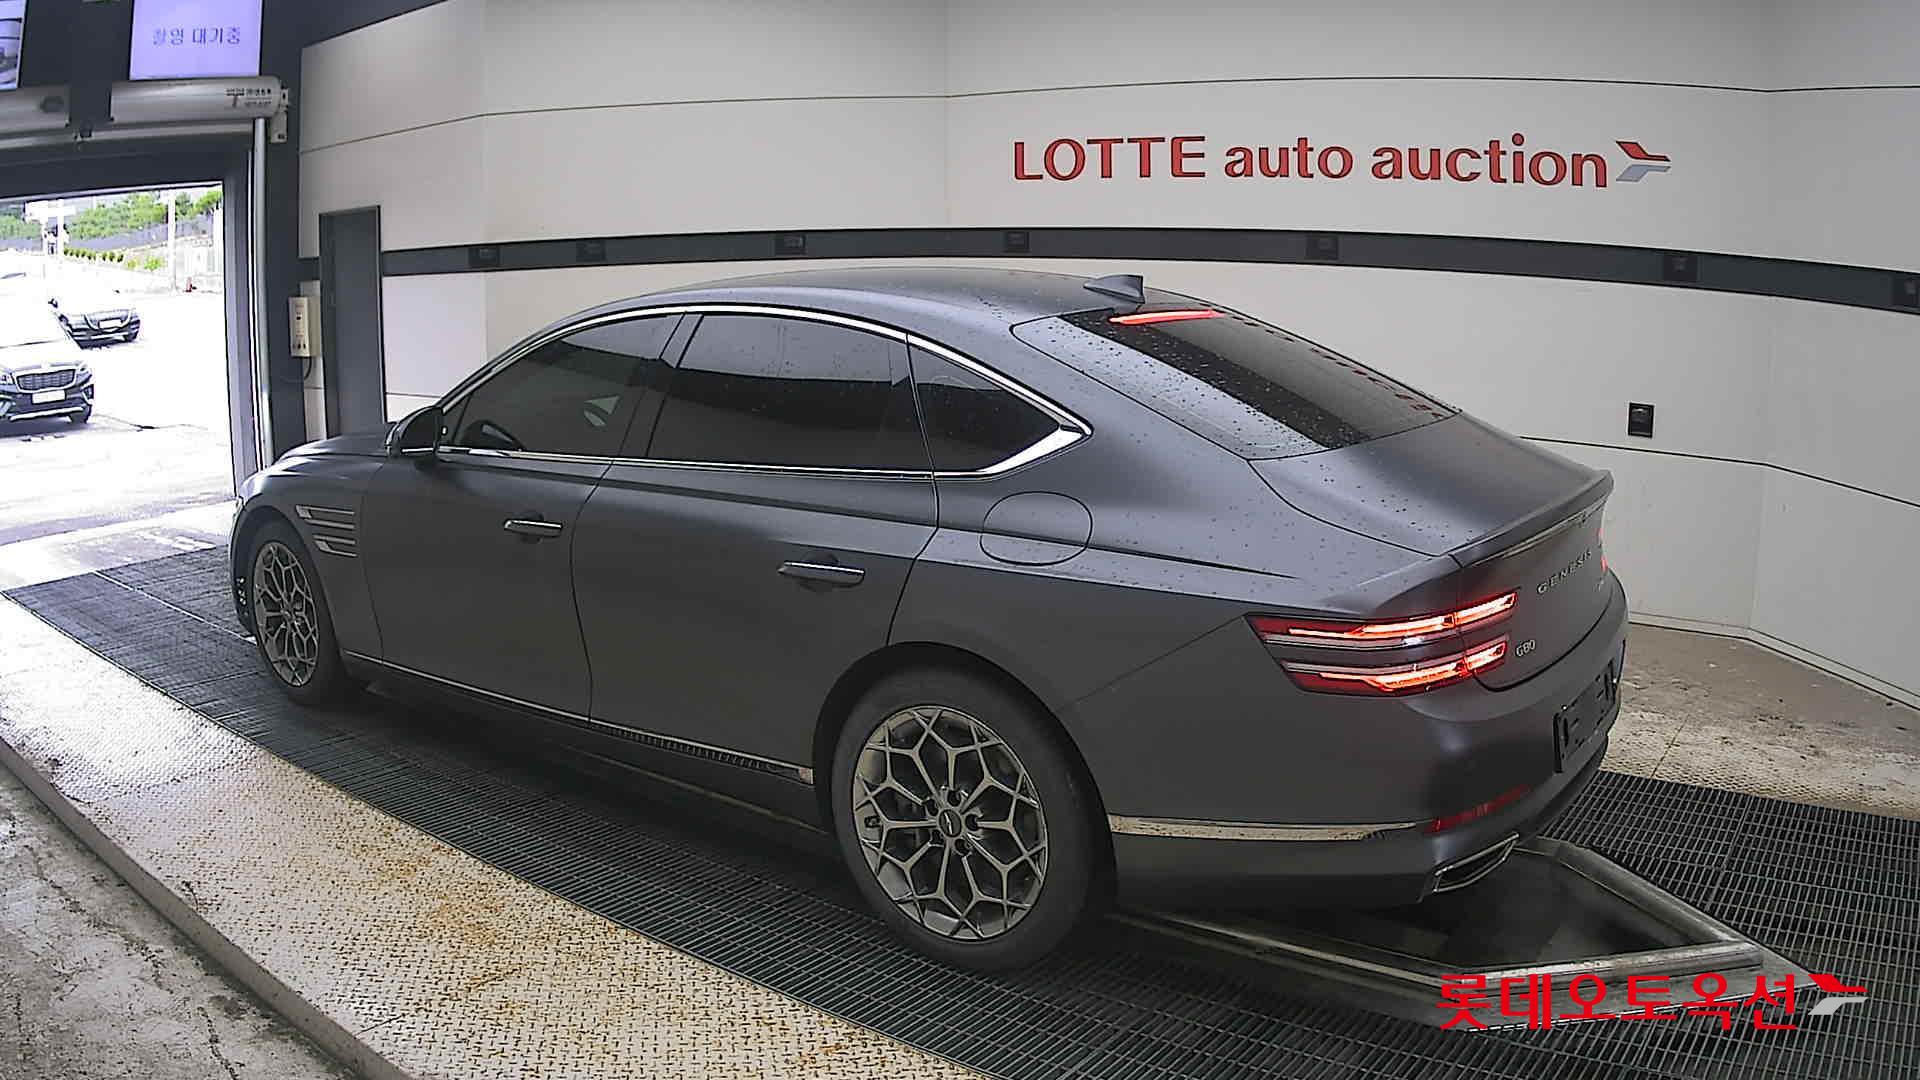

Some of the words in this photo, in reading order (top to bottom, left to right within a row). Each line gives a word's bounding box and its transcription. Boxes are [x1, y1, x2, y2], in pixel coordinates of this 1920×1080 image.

[192, 27, 241, 45] 대기중
[1014, 136, 1206, 181] LOTTE
[1224, 136, 1354, 179] auto
[1371, 132, 1607, 188] auction
[1537, 549, 1592, 594] GENESIS
[1515, 639, 1536, 657] G80
